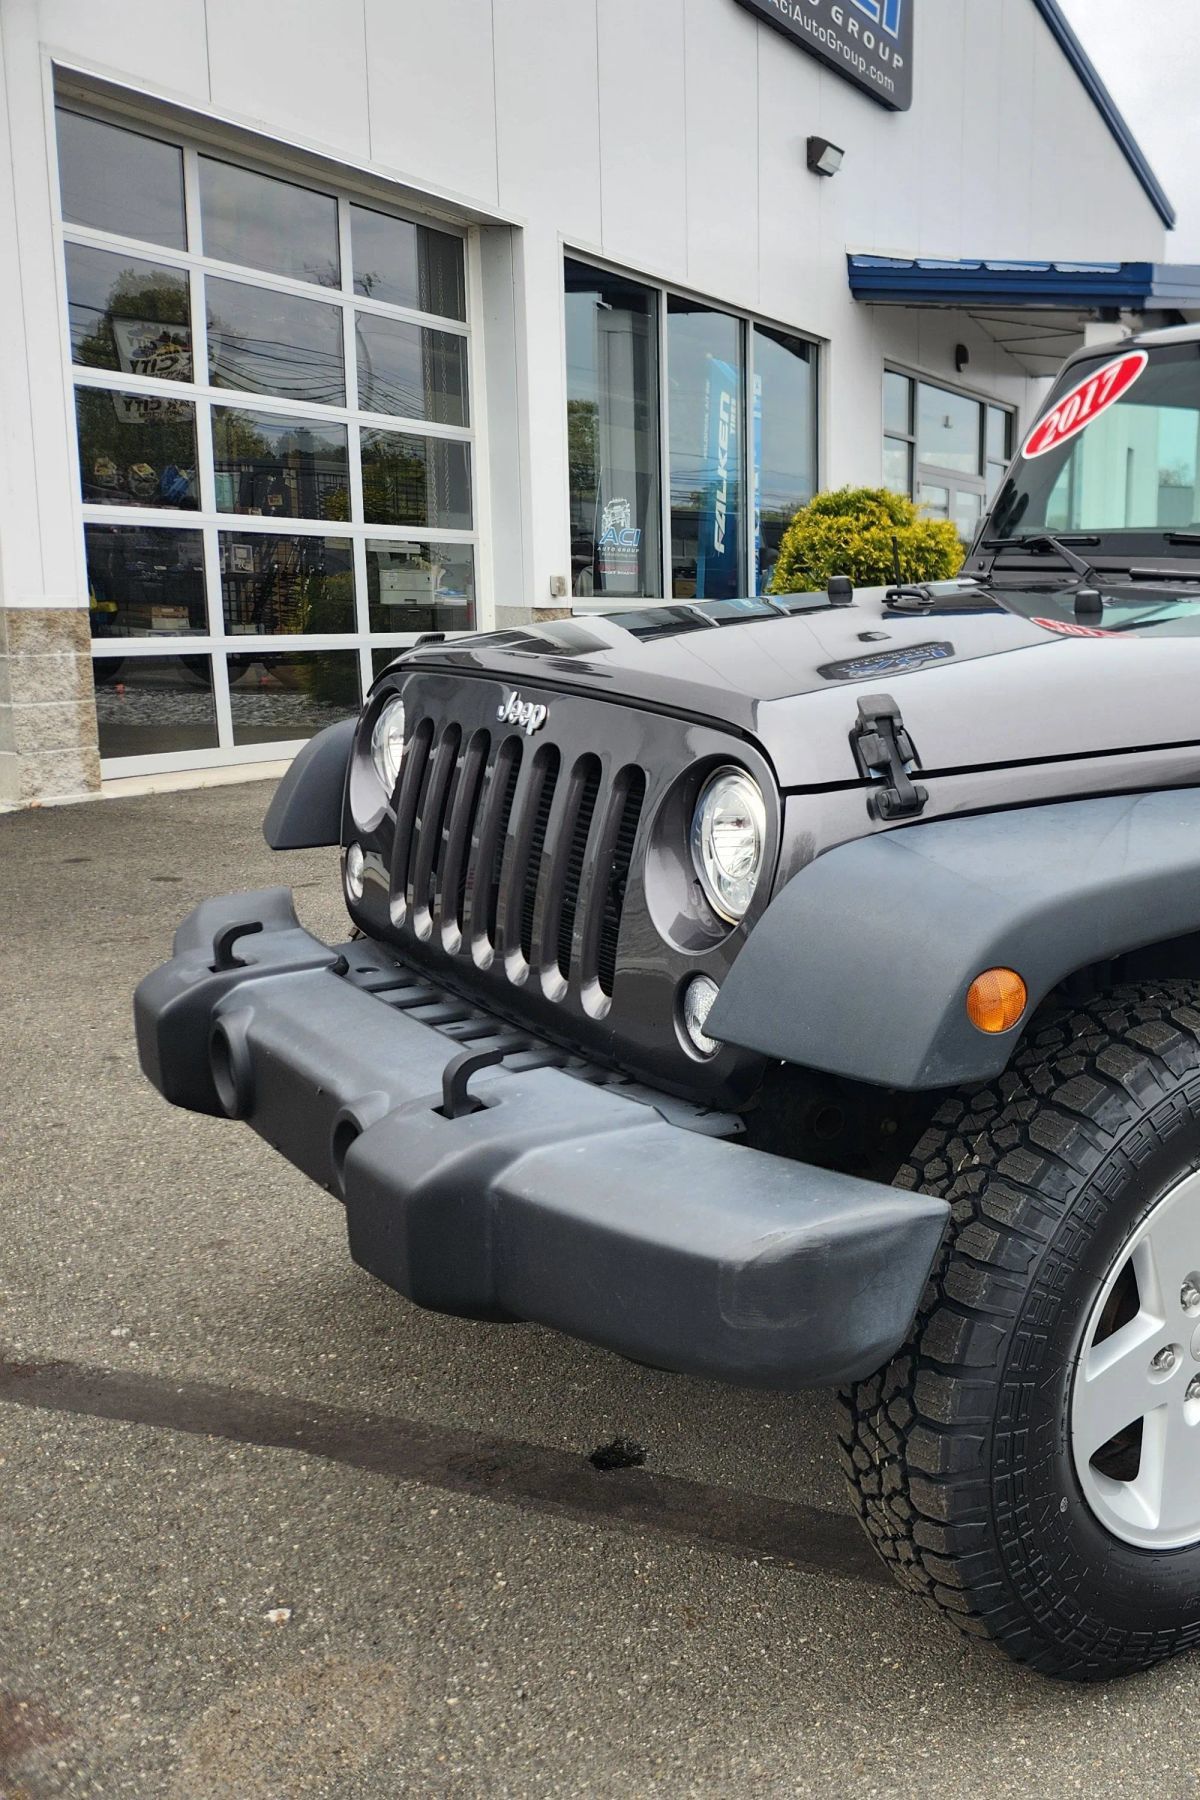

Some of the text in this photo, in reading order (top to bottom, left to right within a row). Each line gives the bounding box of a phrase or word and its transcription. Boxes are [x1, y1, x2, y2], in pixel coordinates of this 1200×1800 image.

[830, 5, 904, 70] GROUP
[1038, 361, 1123, 451] 2017
[714, 391, 731, 554] FALKEN
[599, 526, 642, 547] ACI
[496, 691, 548, 736] Jeep
